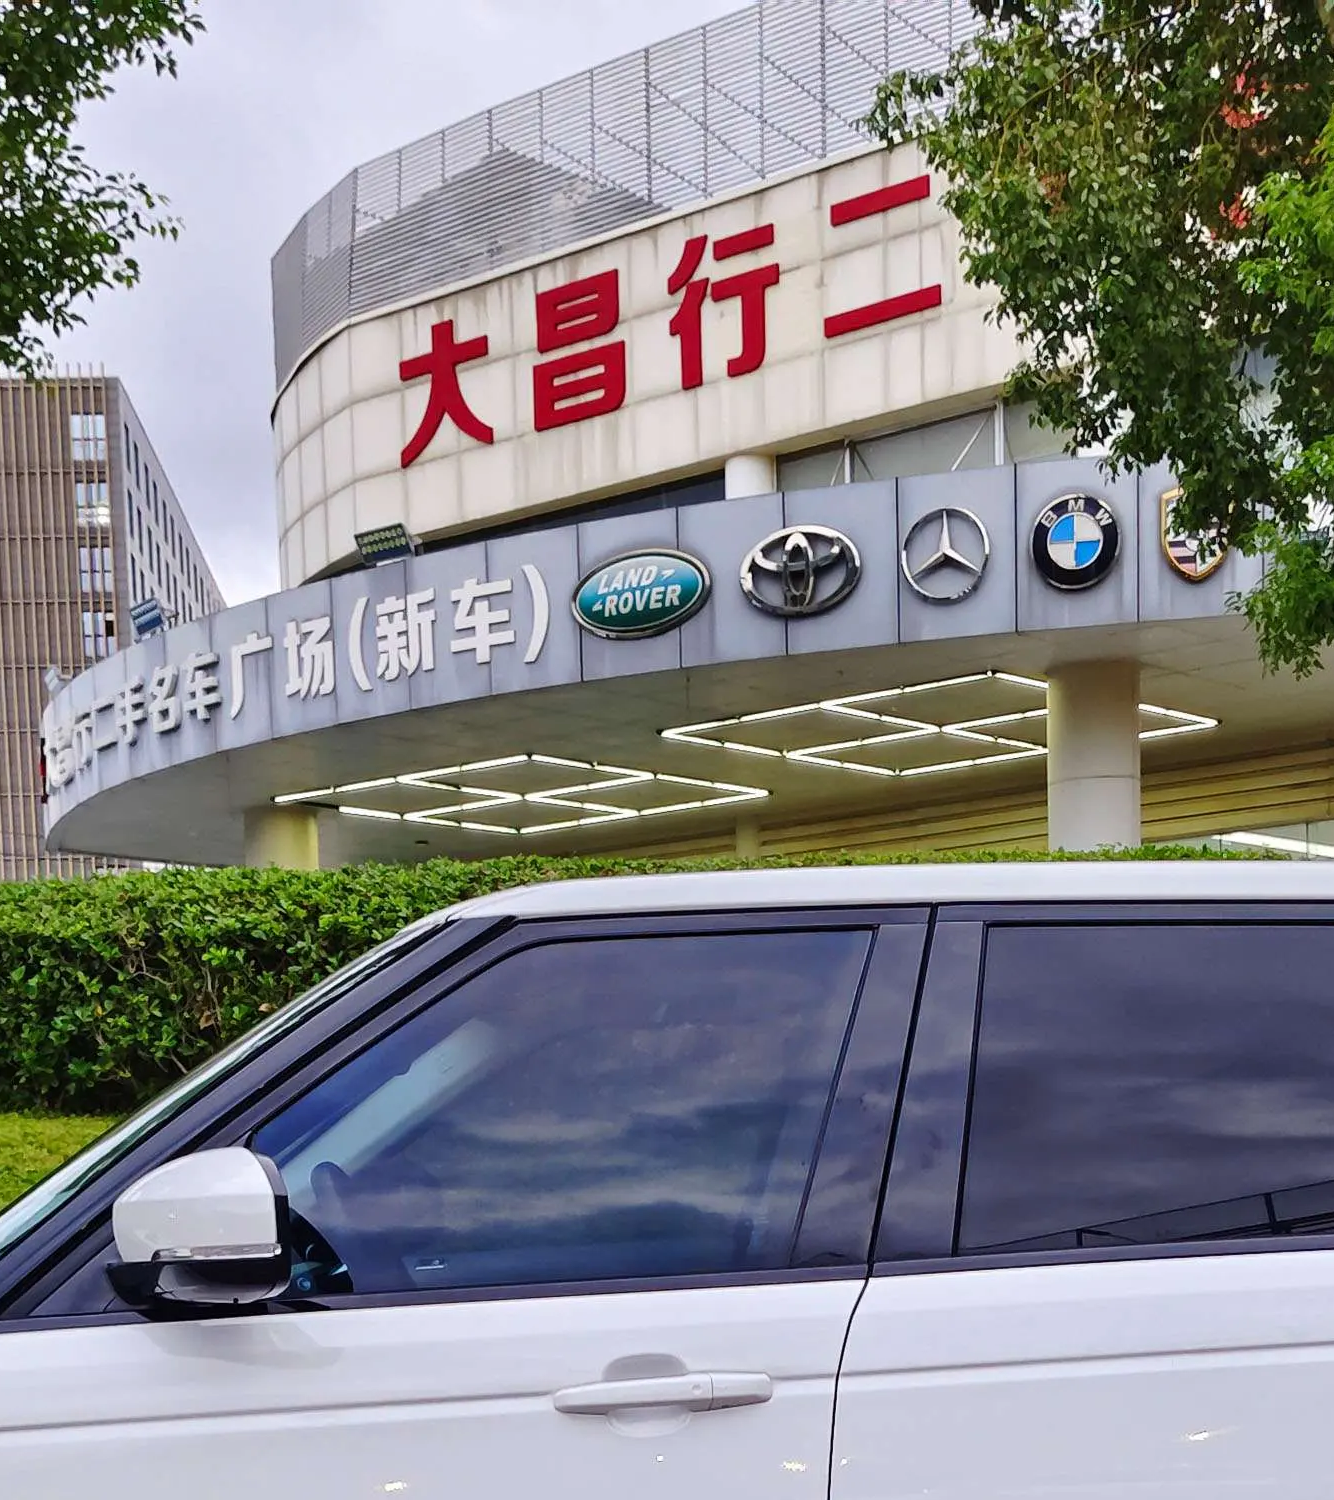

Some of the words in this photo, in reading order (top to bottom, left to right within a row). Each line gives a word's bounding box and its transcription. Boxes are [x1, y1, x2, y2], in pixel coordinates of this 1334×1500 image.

[399, 174, 942, 469] 大昌行二
[1040, 498, 1113, 528] BMW
[597, 565, 658, 595] LAND
[604, 584, 682, 618] ROVER
